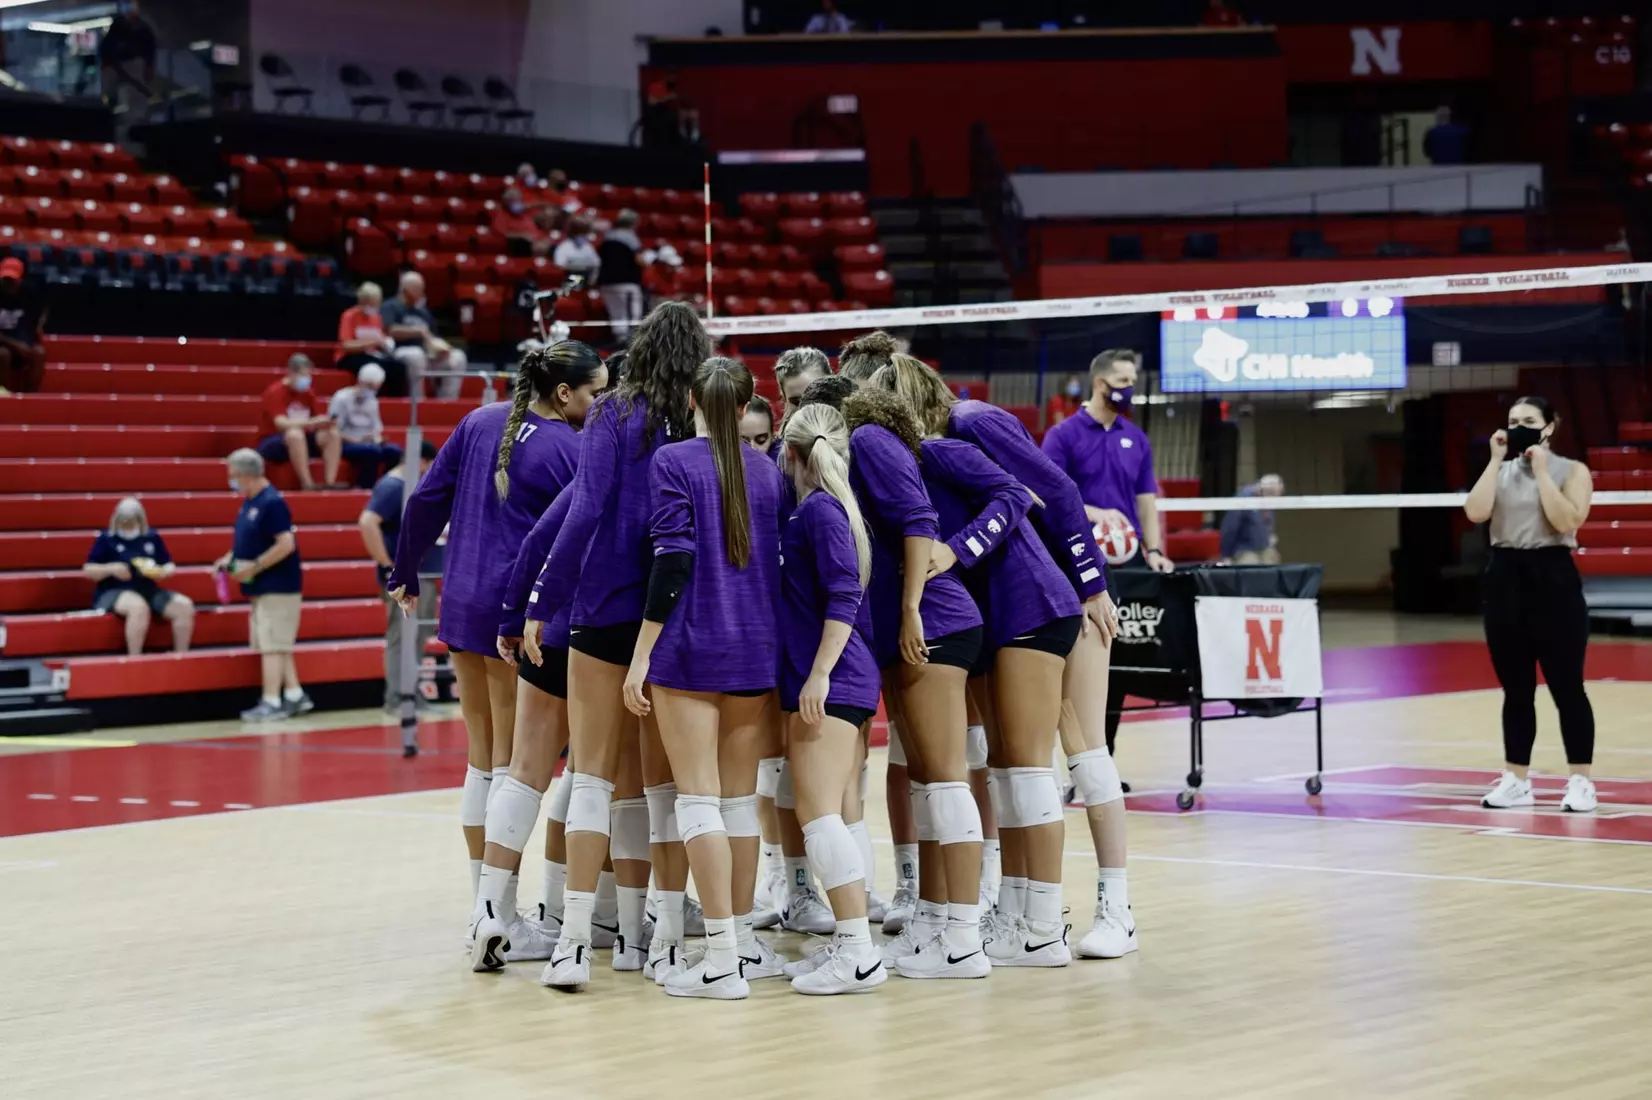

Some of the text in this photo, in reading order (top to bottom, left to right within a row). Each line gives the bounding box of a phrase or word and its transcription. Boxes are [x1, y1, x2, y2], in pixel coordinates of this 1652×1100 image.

[1350, 26, 1402, 75] N
[516, 422, 538, 443] 17
[1116, 597, 1165, 626] olley
[1116, 620, 1158, 638] ART
[1245, 619, 1283, 680] N
